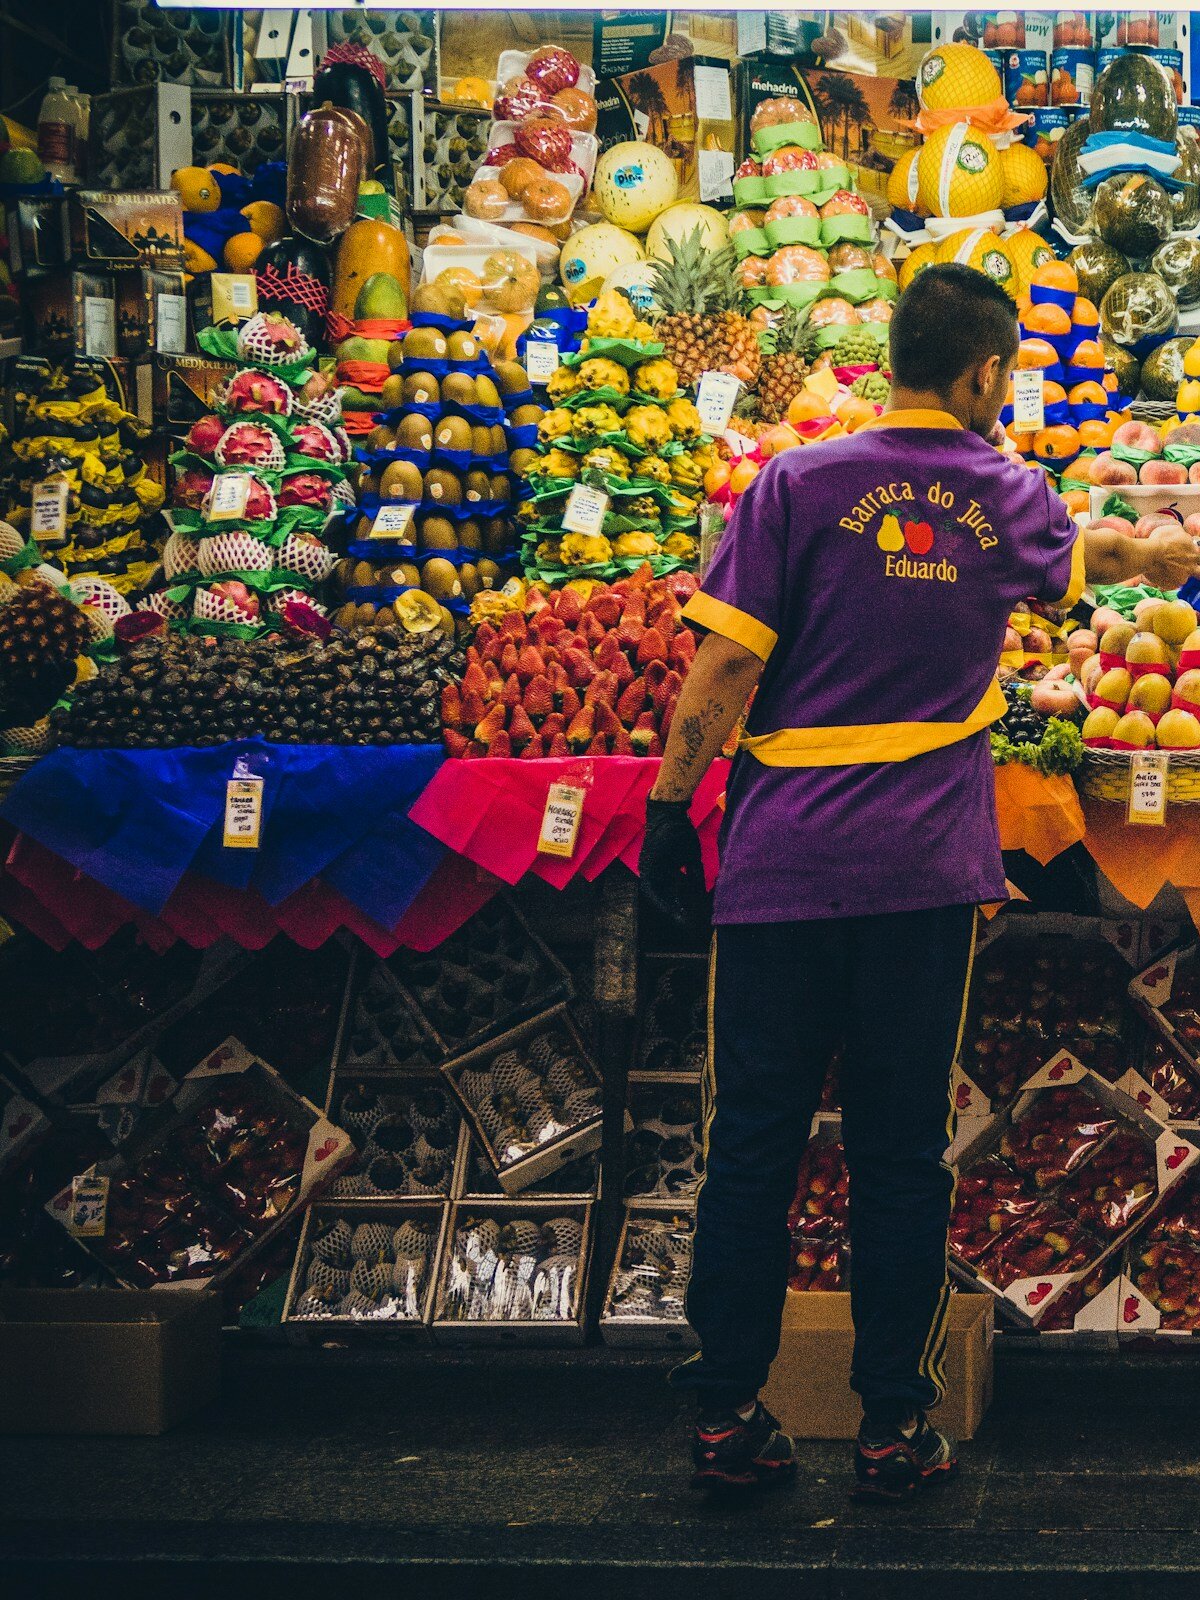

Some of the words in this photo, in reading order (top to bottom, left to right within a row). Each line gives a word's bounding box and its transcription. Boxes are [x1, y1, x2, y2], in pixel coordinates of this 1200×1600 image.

[752, 81, 798, 96] mehadrin
[839, 481, 916, 535] Barraca
[927, 481, 955, 509] do
[957, 499, 999, 551] Juca
[885, 554, 958, 583] Eduardo
[548, 805, 577, 818] MORANGO
[555, 817, 574, 826] EXTRA
